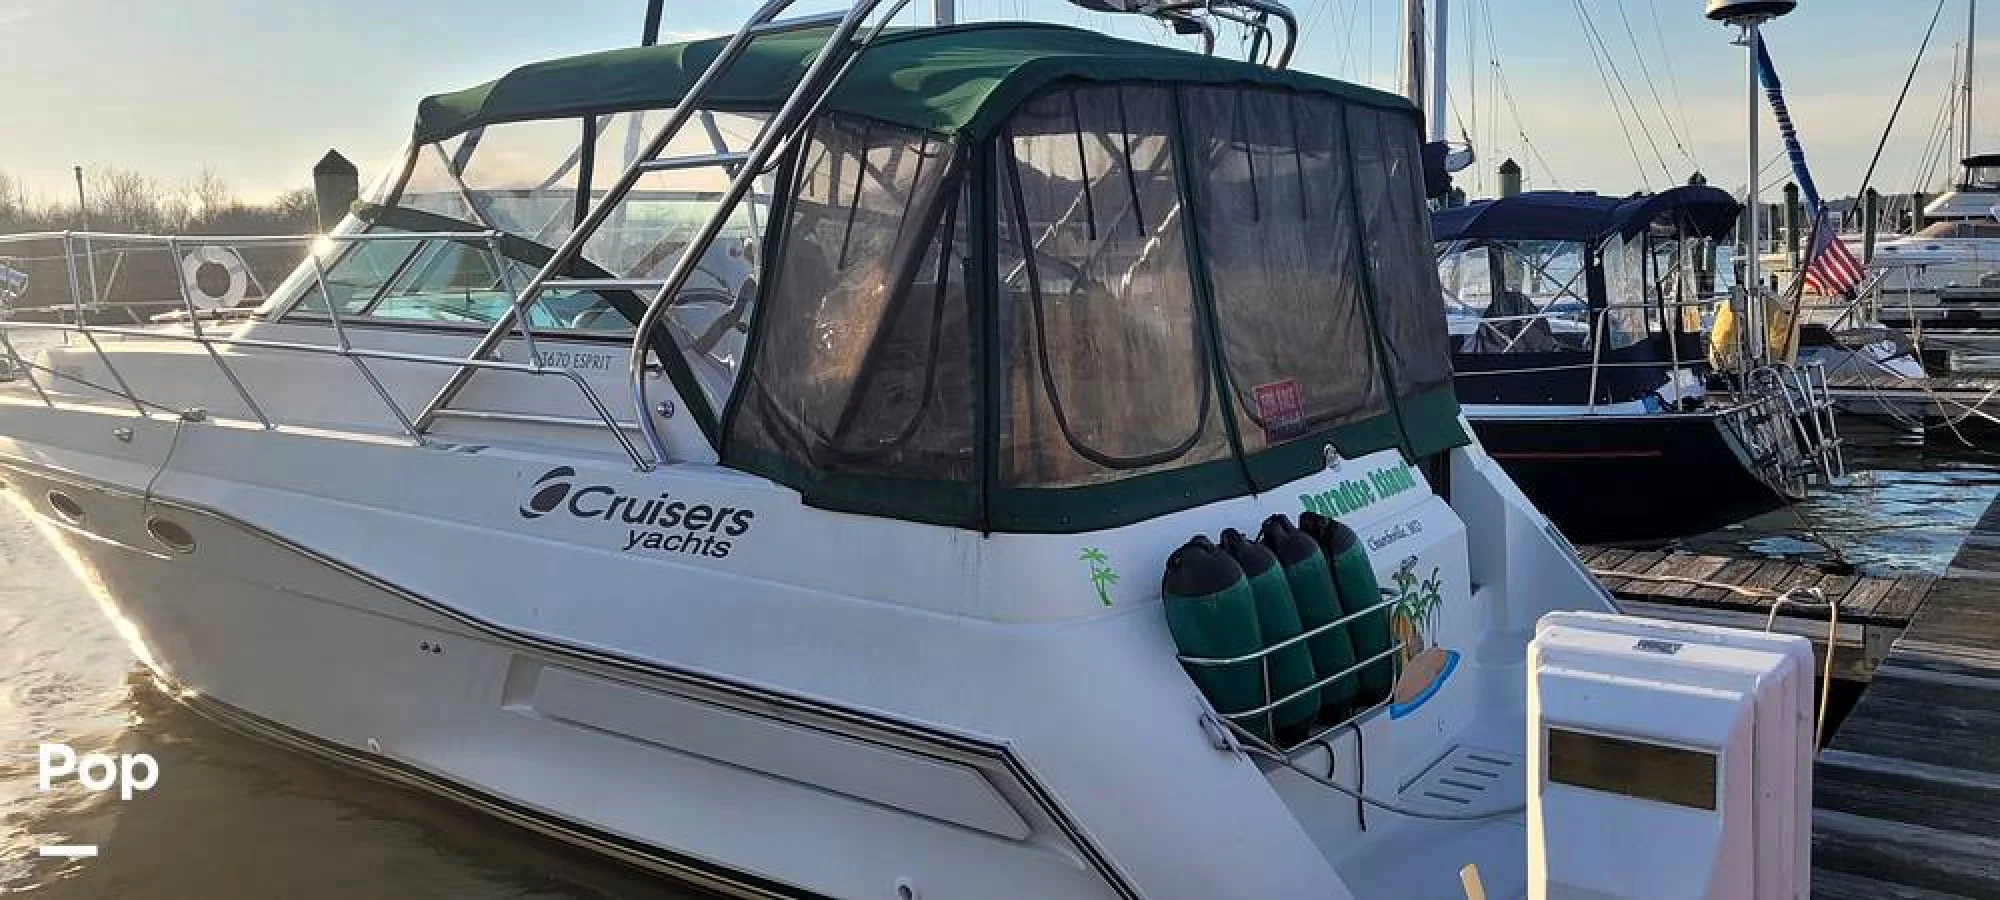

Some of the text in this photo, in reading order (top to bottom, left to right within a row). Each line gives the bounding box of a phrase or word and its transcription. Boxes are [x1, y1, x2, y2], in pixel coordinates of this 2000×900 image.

[573, 353, 612, 370] ESPRIT
[1298, 460, 1416, 517] Paradise Island
[568, 485, 754, 537] Cruisers
[622, 529, 732, 559] yachts
